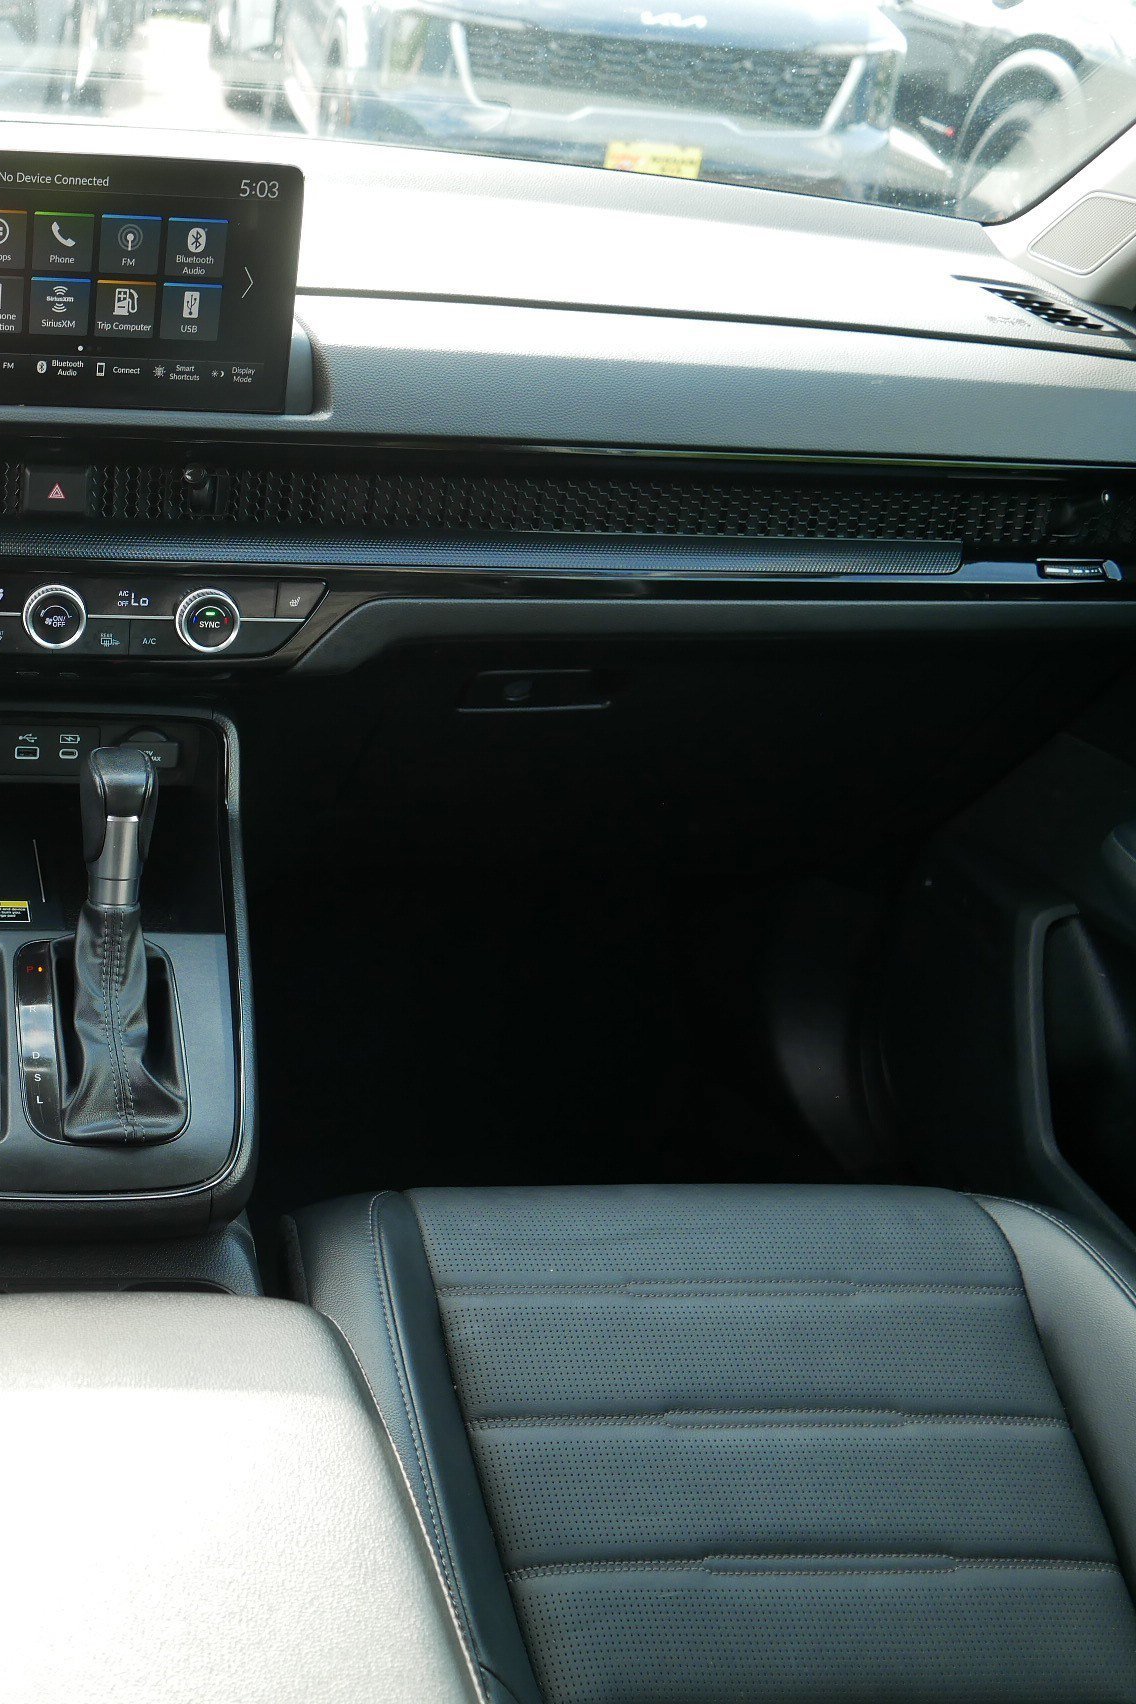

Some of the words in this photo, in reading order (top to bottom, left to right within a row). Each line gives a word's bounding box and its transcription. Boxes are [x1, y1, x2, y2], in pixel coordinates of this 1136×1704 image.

[16, 172, 52, 184] Device
[54, 174, 110, 187] Connected
[239, 180, 279, 198] 5:03
[49, 255, 74, 264] Phone
[122, 258, 136, 266] FM
[176, 255, 214, 264] Bluetooth
[182, 267, 206, 275] Audio
[41, 319, 76, 328] SiriusXM
[97, 322, 112, 331] Trip
[112, 322, 152, 332] Computer
[180, 324, 198, 333] USB
[52, 360, 84, 368] Bluetooth
[176, 364, 195, 372] Smart
[57, 368, 77, 376] Audio
[112, 366, 140, 375] Connect
[232, 366, 256, 376] Display
[170, 373, 200, 381] Shortcuts
[233, 376, 252, 384] Mode
[132, 592, 149, 606] Lo
[198, 621, 221, 629] SYNC
[34, 1074, 42, 1082] S
[36, 1096, 44, 1104] L
